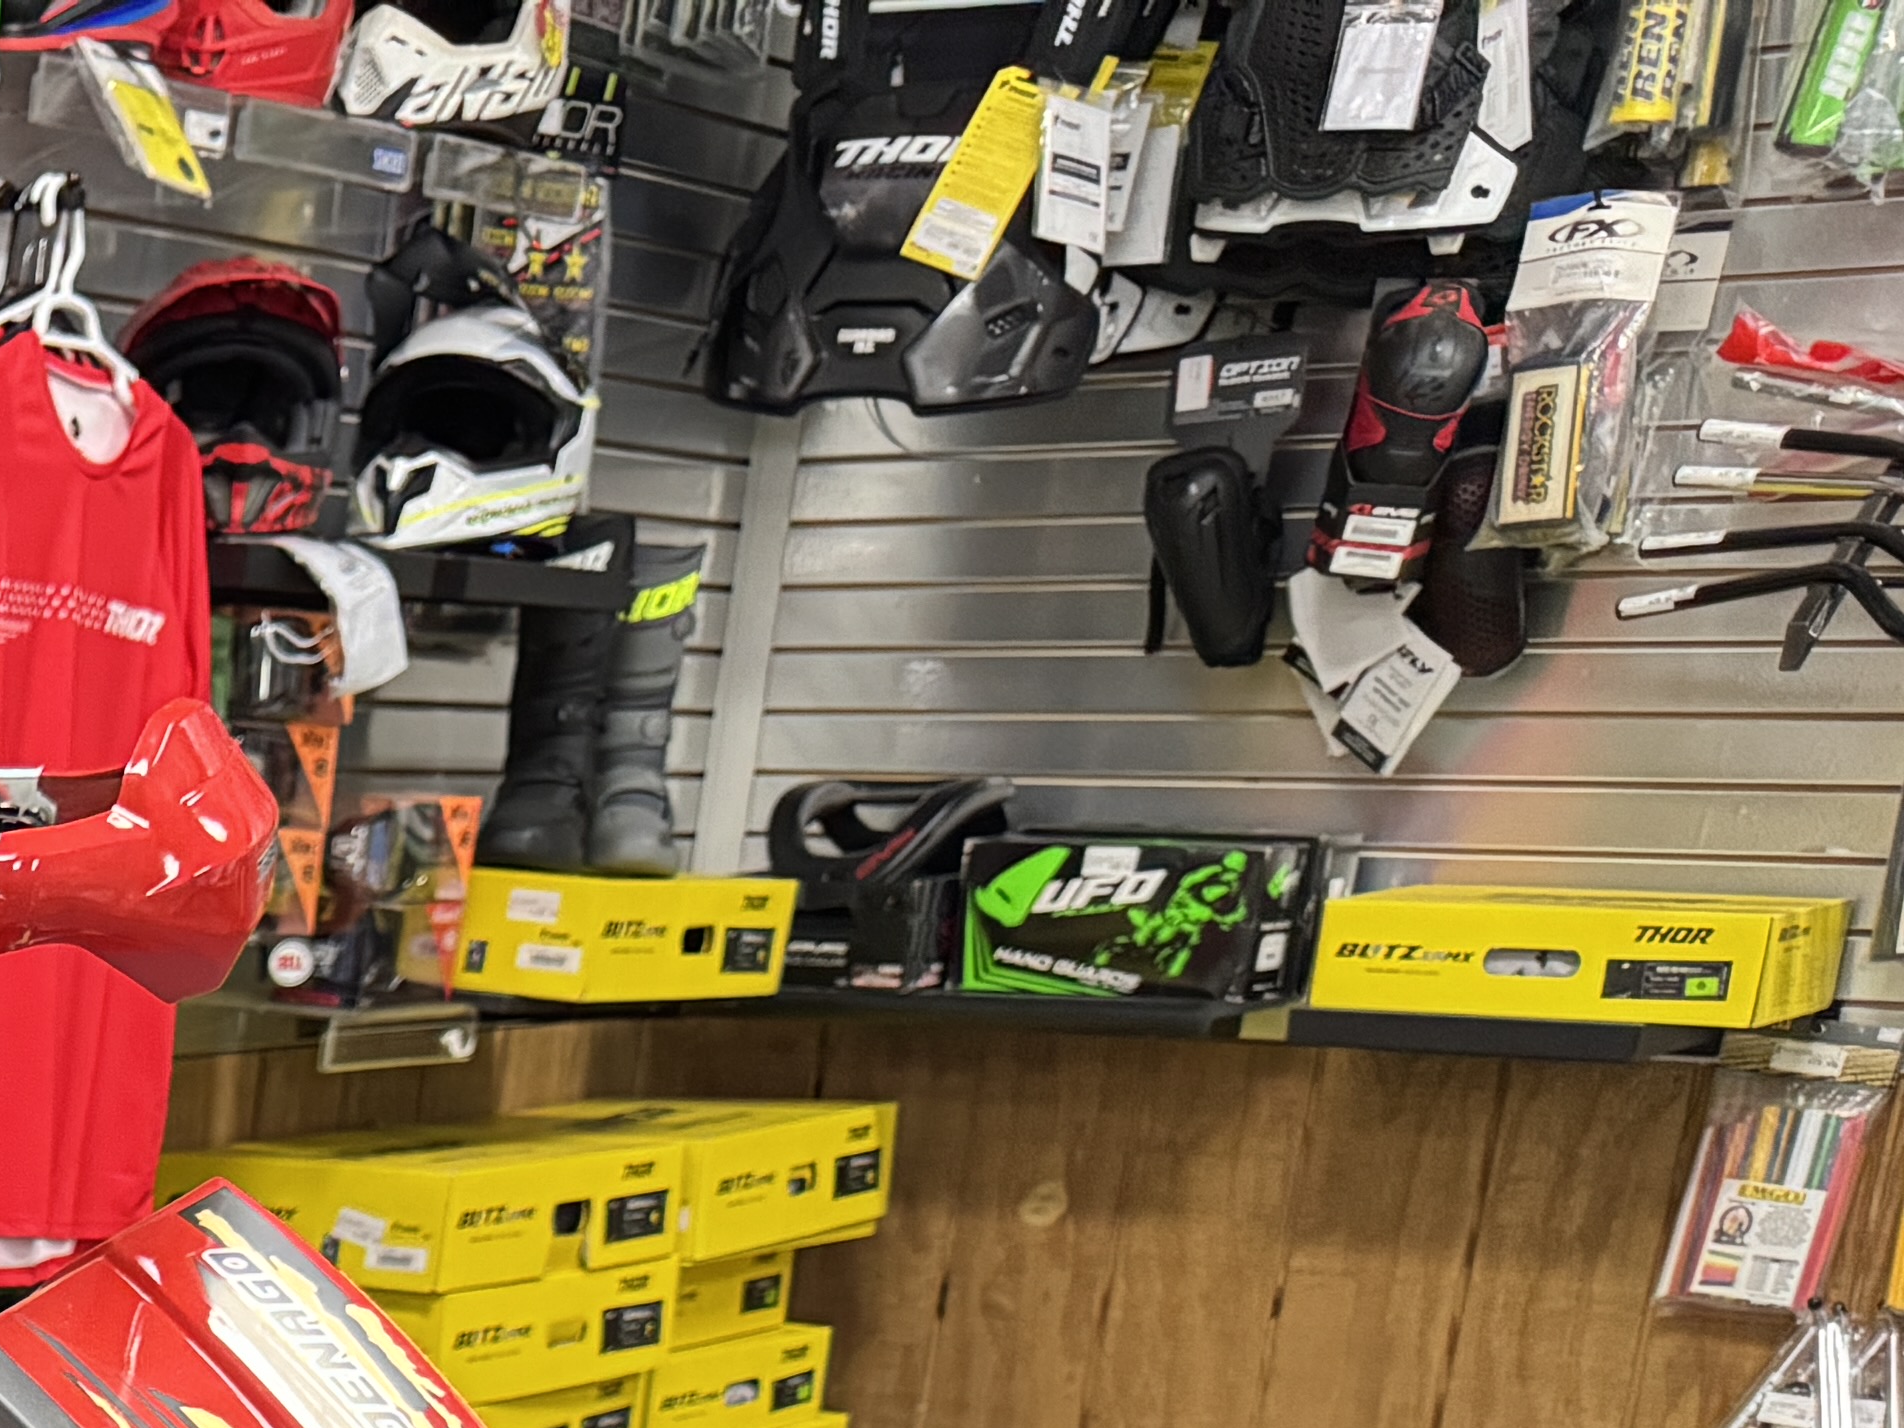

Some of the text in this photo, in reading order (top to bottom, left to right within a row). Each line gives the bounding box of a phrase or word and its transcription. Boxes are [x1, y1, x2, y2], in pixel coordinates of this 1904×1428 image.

[835, 135, 962, 169] THO
[1031, 868, 1169, 914] UFO
[1633, 925, 1715, 945] THOR
